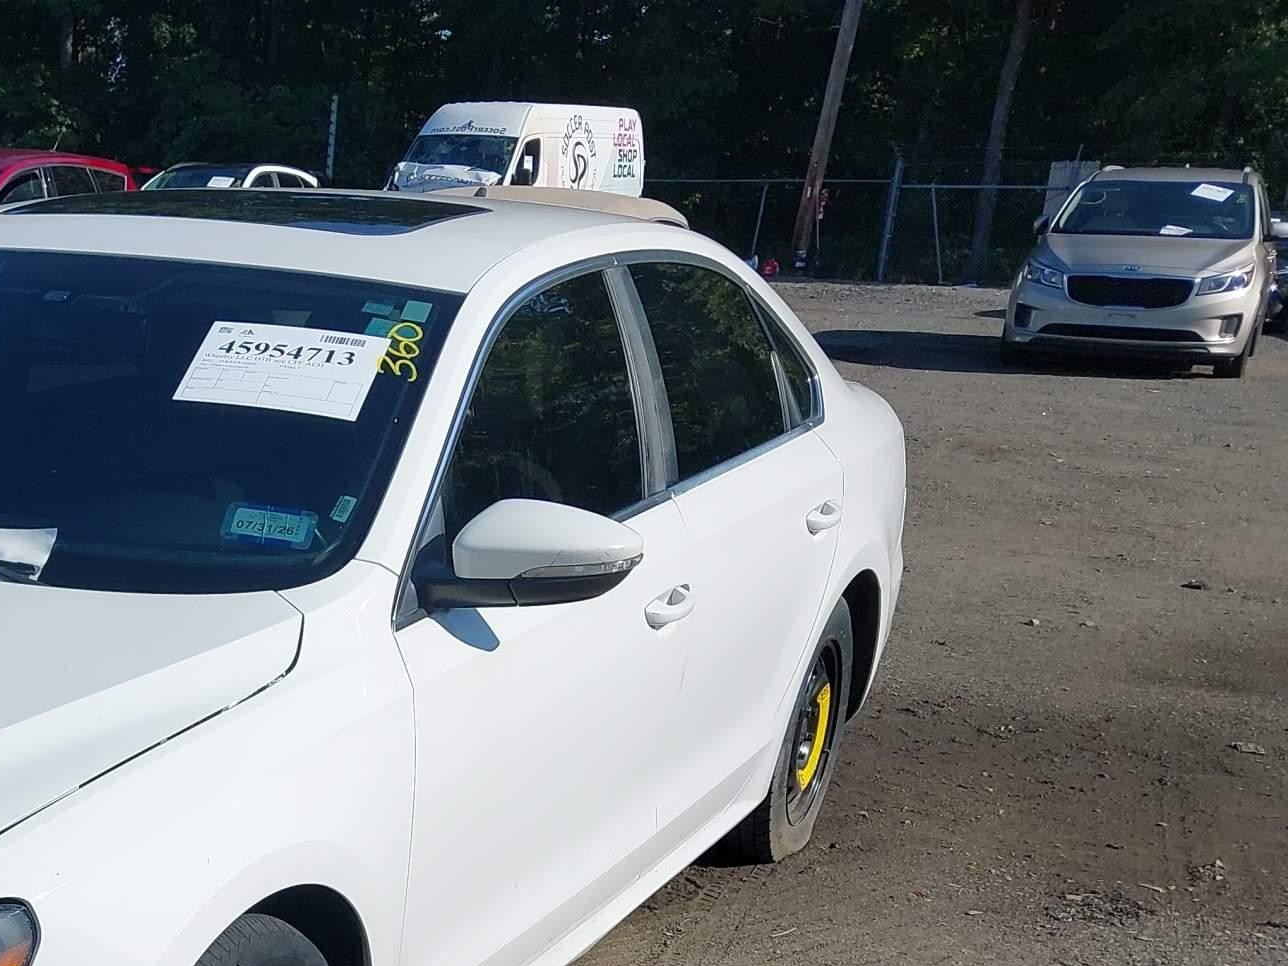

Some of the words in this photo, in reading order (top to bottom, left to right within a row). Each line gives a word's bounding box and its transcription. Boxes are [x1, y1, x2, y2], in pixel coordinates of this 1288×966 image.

[618, 117, 637, 132] PLAY
[561, 114, 583, 158] SOCCER
[583, 121, 597, 159] POST
[613, 133, 636, 147] LOCAL
[617, 148, 638, 163] SHOP
[612, 164, 636, 178] LOCAL
[218, 339, 356, 367] 45954713
[376, 321, 425, 383] 360
[235, 519, 296, 536] 07/31/26
